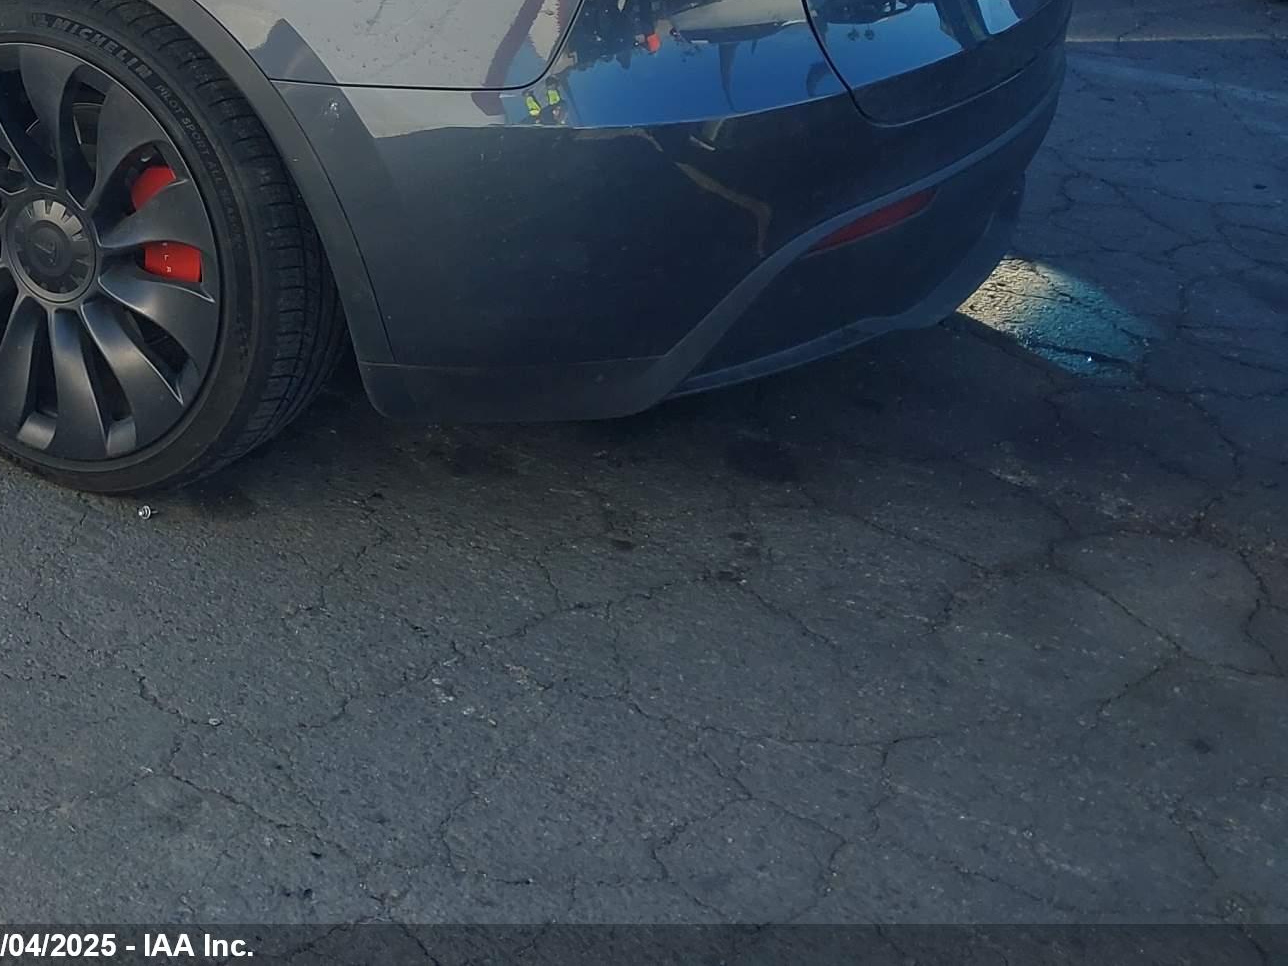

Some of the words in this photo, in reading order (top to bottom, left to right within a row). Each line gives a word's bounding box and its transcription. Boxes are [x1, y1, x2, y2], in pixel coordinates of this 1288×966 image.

[51, 17, 153, 79] MICHELIN
[154, 84, 185, 114] PILOT
[181, 117, 211, 155] SPORT
